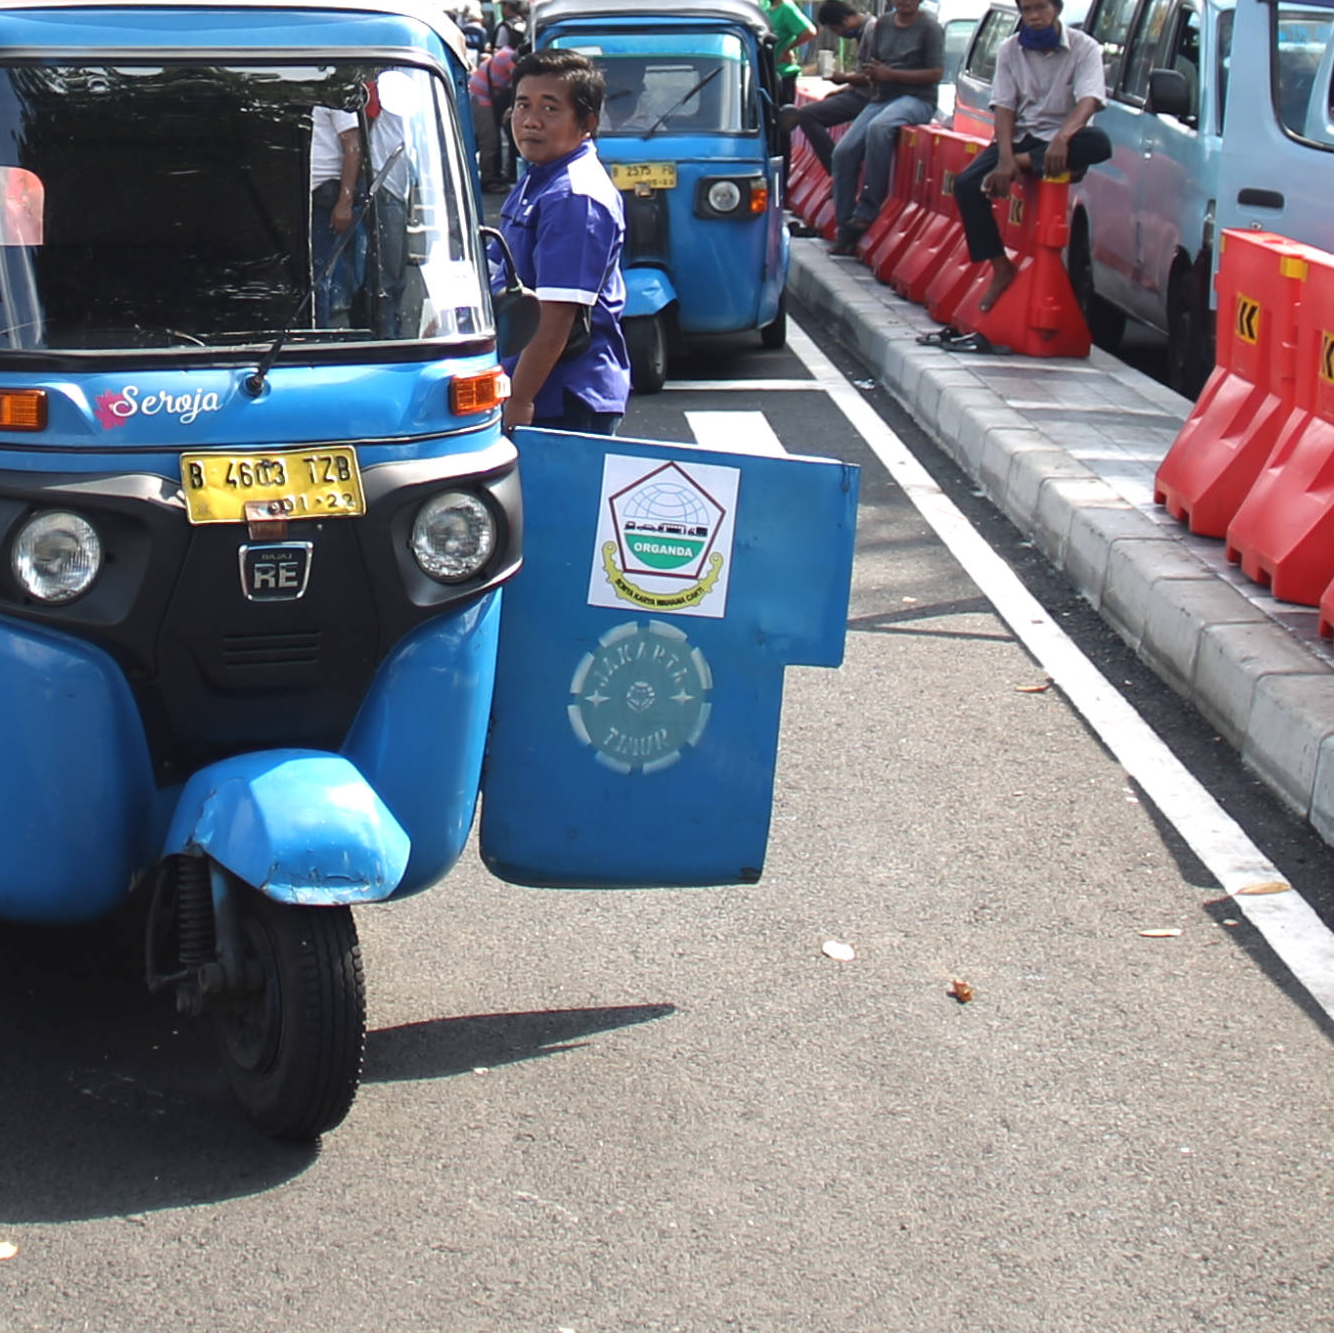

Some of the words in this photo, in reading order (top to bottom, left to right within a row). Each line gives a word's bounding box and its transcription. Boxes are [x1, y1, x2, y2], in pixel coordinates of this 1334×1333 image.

[112, 385, 223, 425] Seroja
[188, 461, 205, 490] B
[225, 458, 287, 489] 4603
[302, 454, 352, 484] TZB
[633, 541, 694, 558] ORGANDA
[253, 561, 299, 589] RE
[593, 641, 688, 688] JAKARTA
[603, 725, 669, 757] TIMUR
